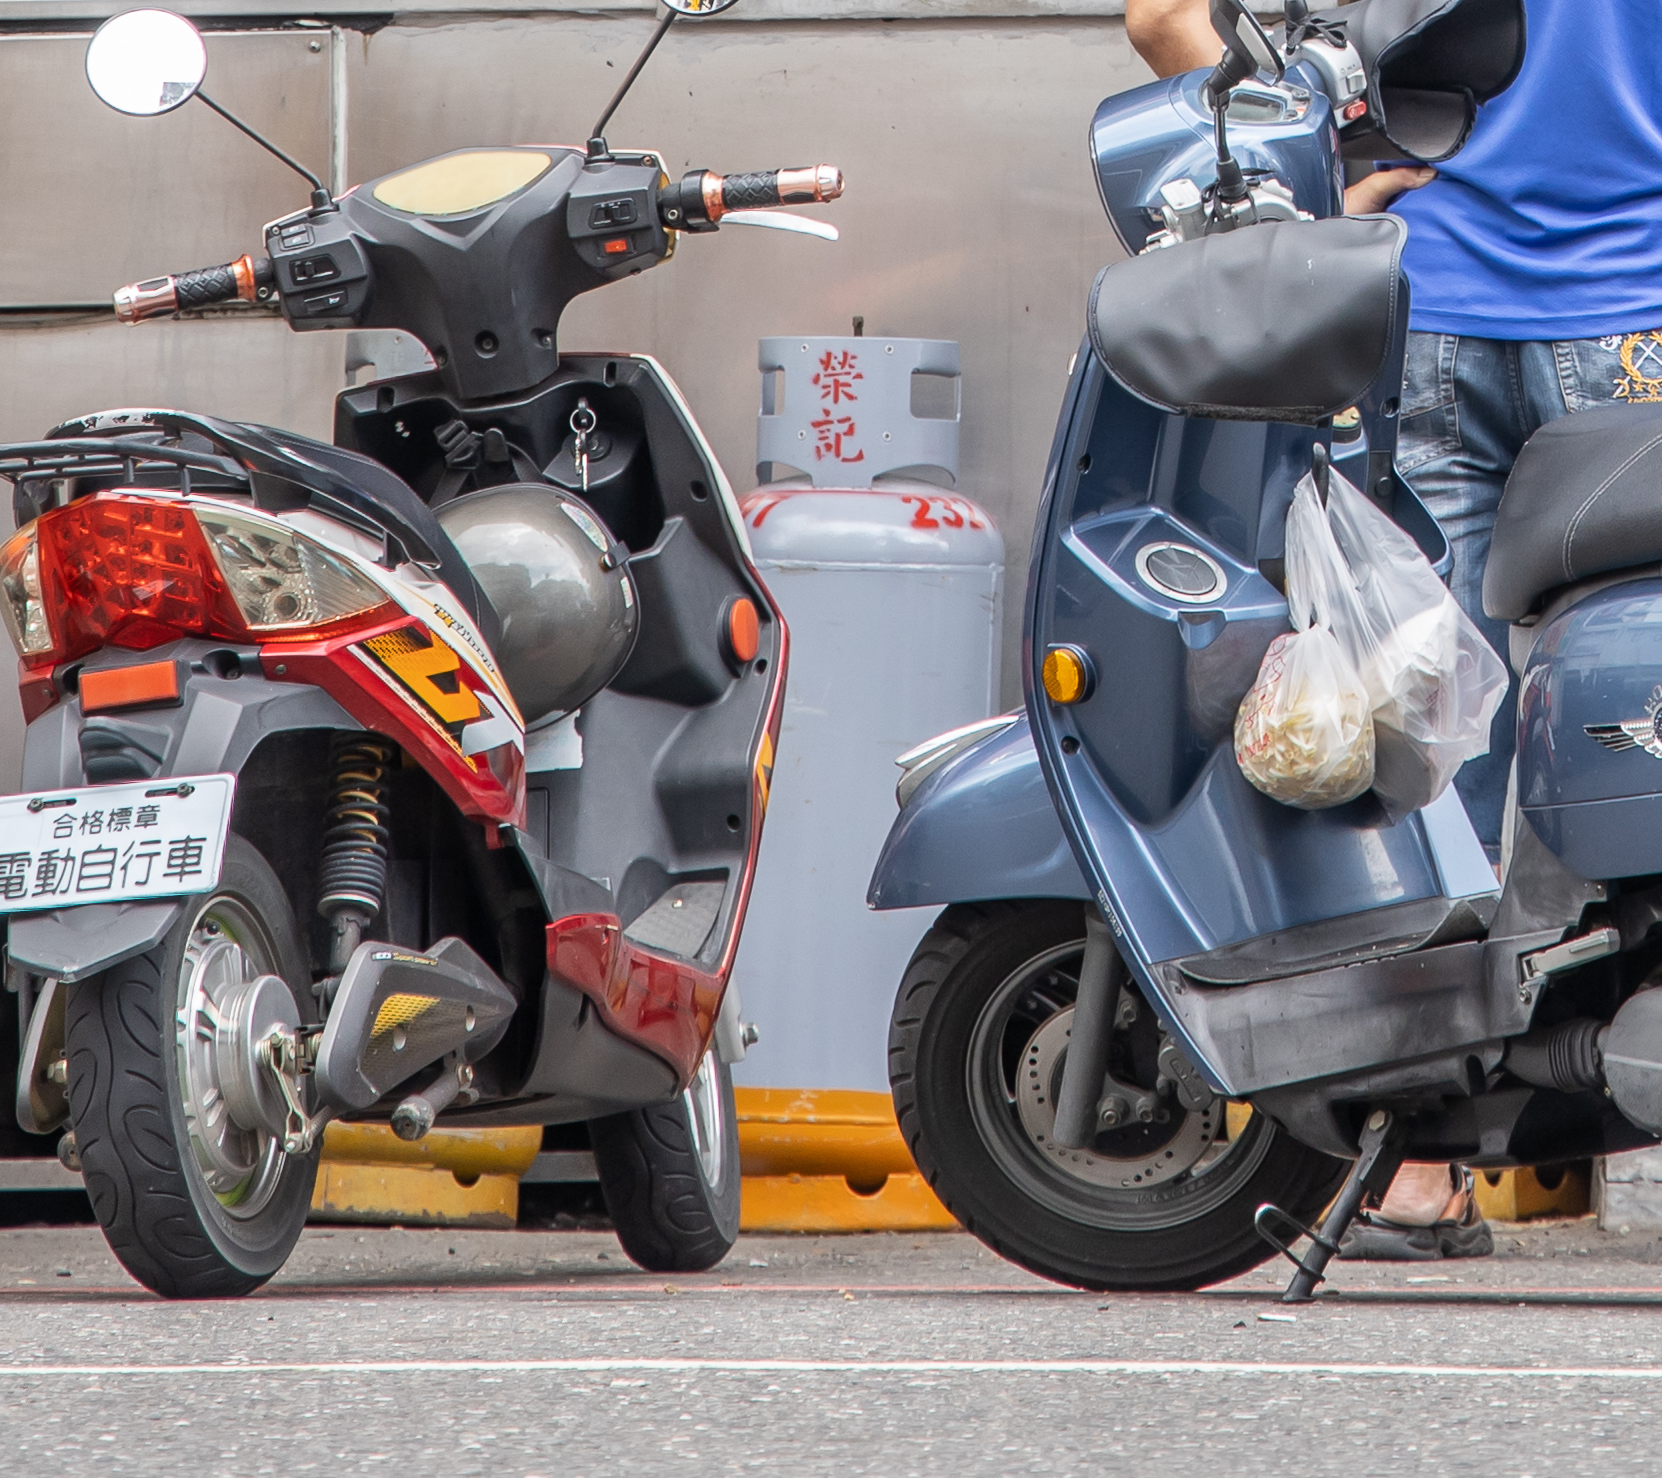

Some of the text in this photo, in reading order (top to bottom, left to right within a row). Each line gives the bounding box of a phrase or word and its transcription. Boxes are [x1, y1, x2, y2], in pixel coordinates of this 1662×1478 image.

[811, 350, 865, 463] 榮記
[53, 805, 161, 839] 合格標章
